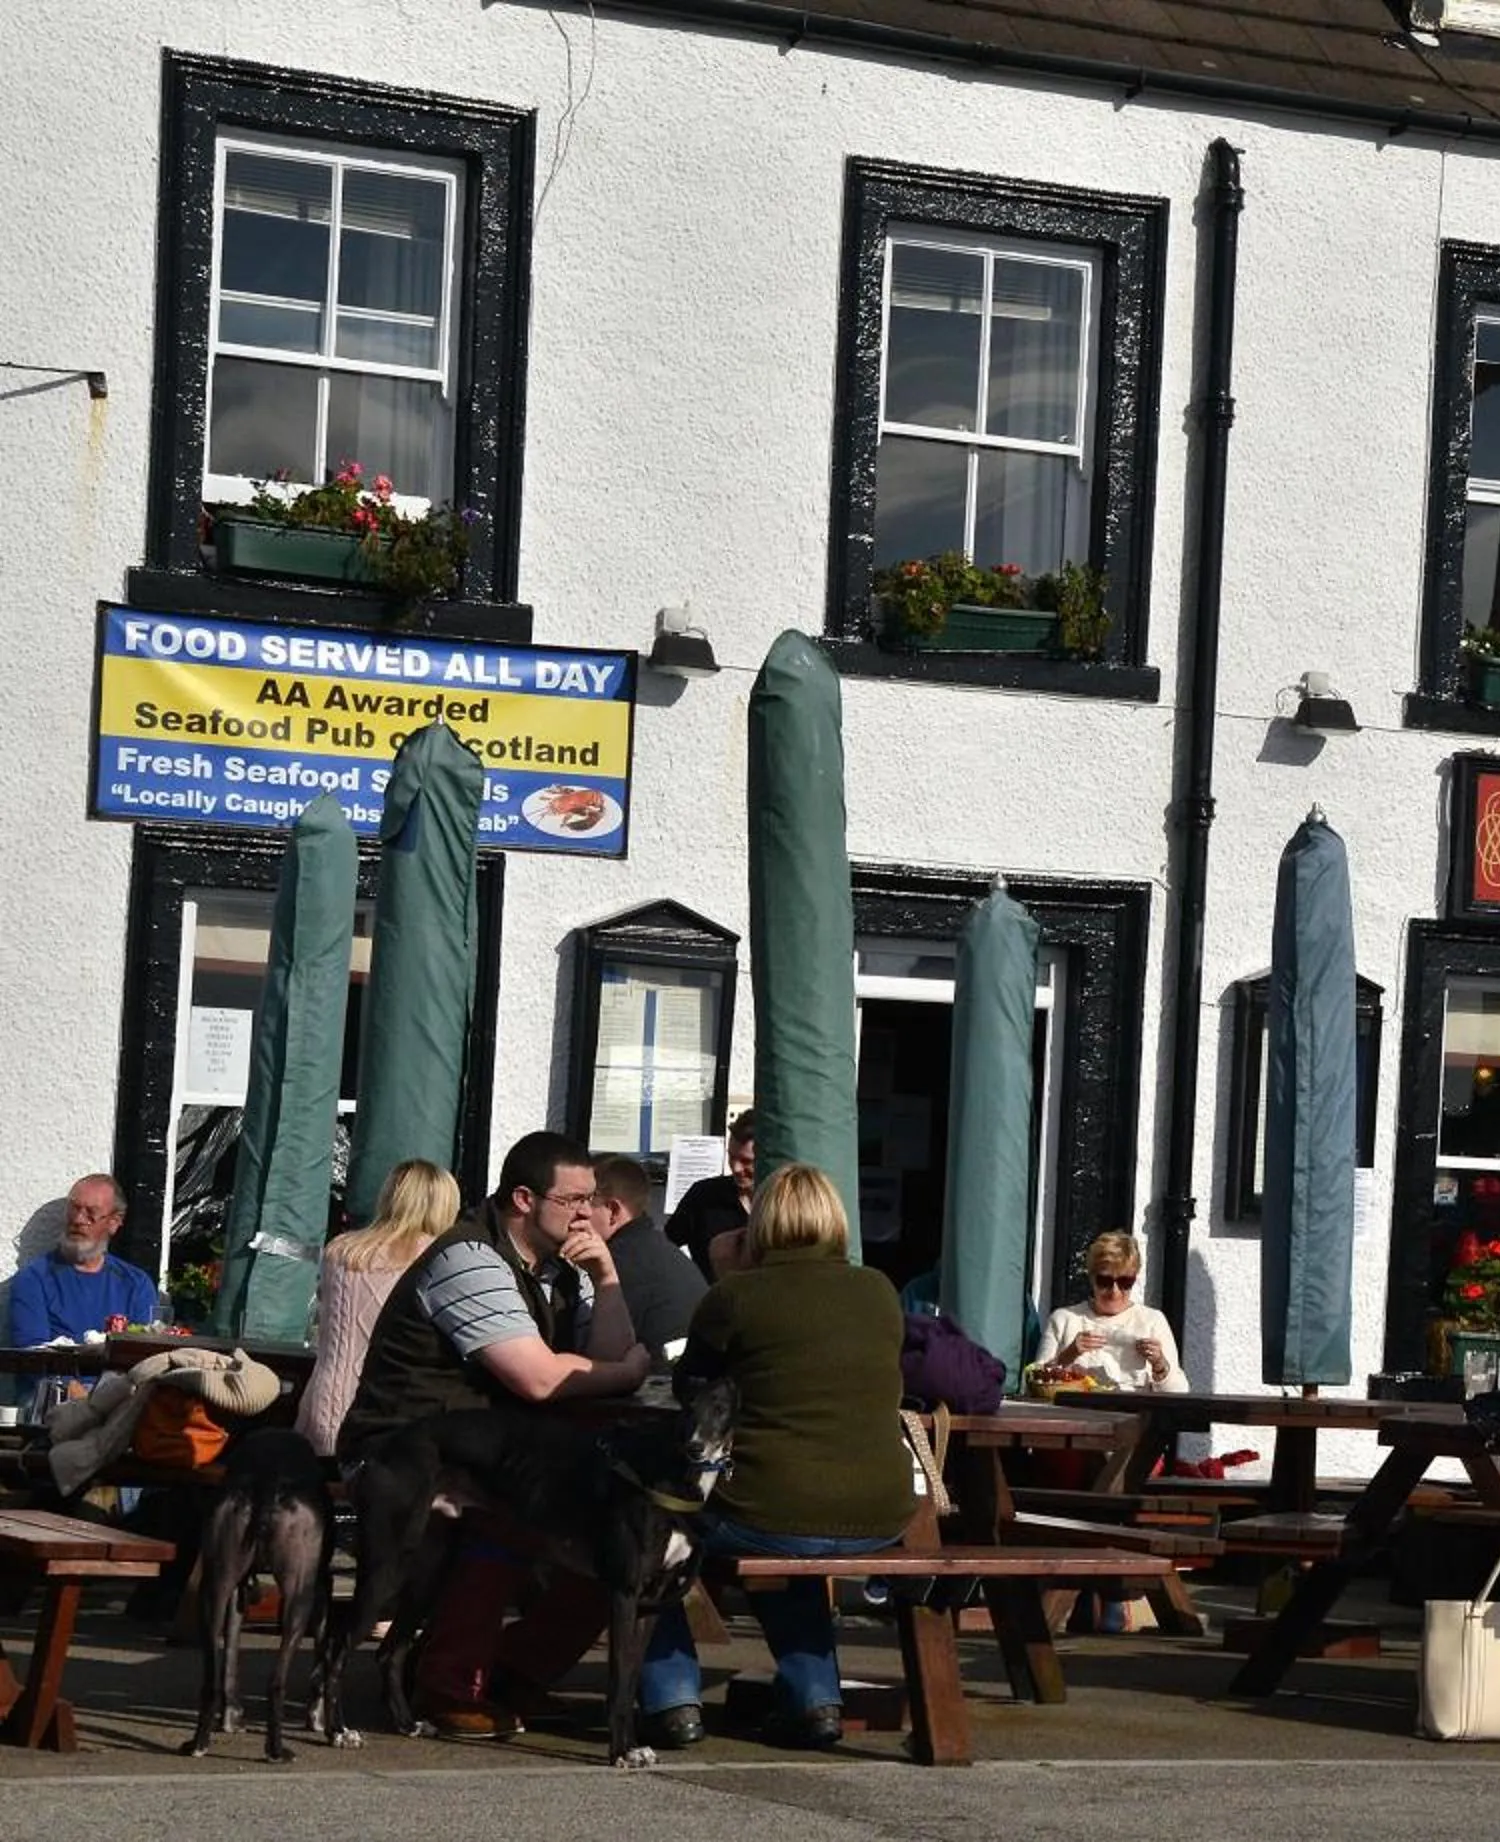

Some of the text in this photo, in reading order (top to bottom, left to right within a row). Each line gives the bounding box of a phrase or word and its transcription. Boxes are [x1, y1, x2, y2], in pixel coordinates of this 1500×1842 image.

[124, 621, 615, 694] FOOD SERVED ALL DAY
[256, 679, 489, 723] AA Awarded
[134, 702, 291, 743] Seafood
[305, 719, 375, 750] Pub
[464, 727, 599, 766] cotland
[117, 747, 212, 779] Fresh
[224, 757, 359, 792] Seafood
[225, 793, 306, 824] Caugh
